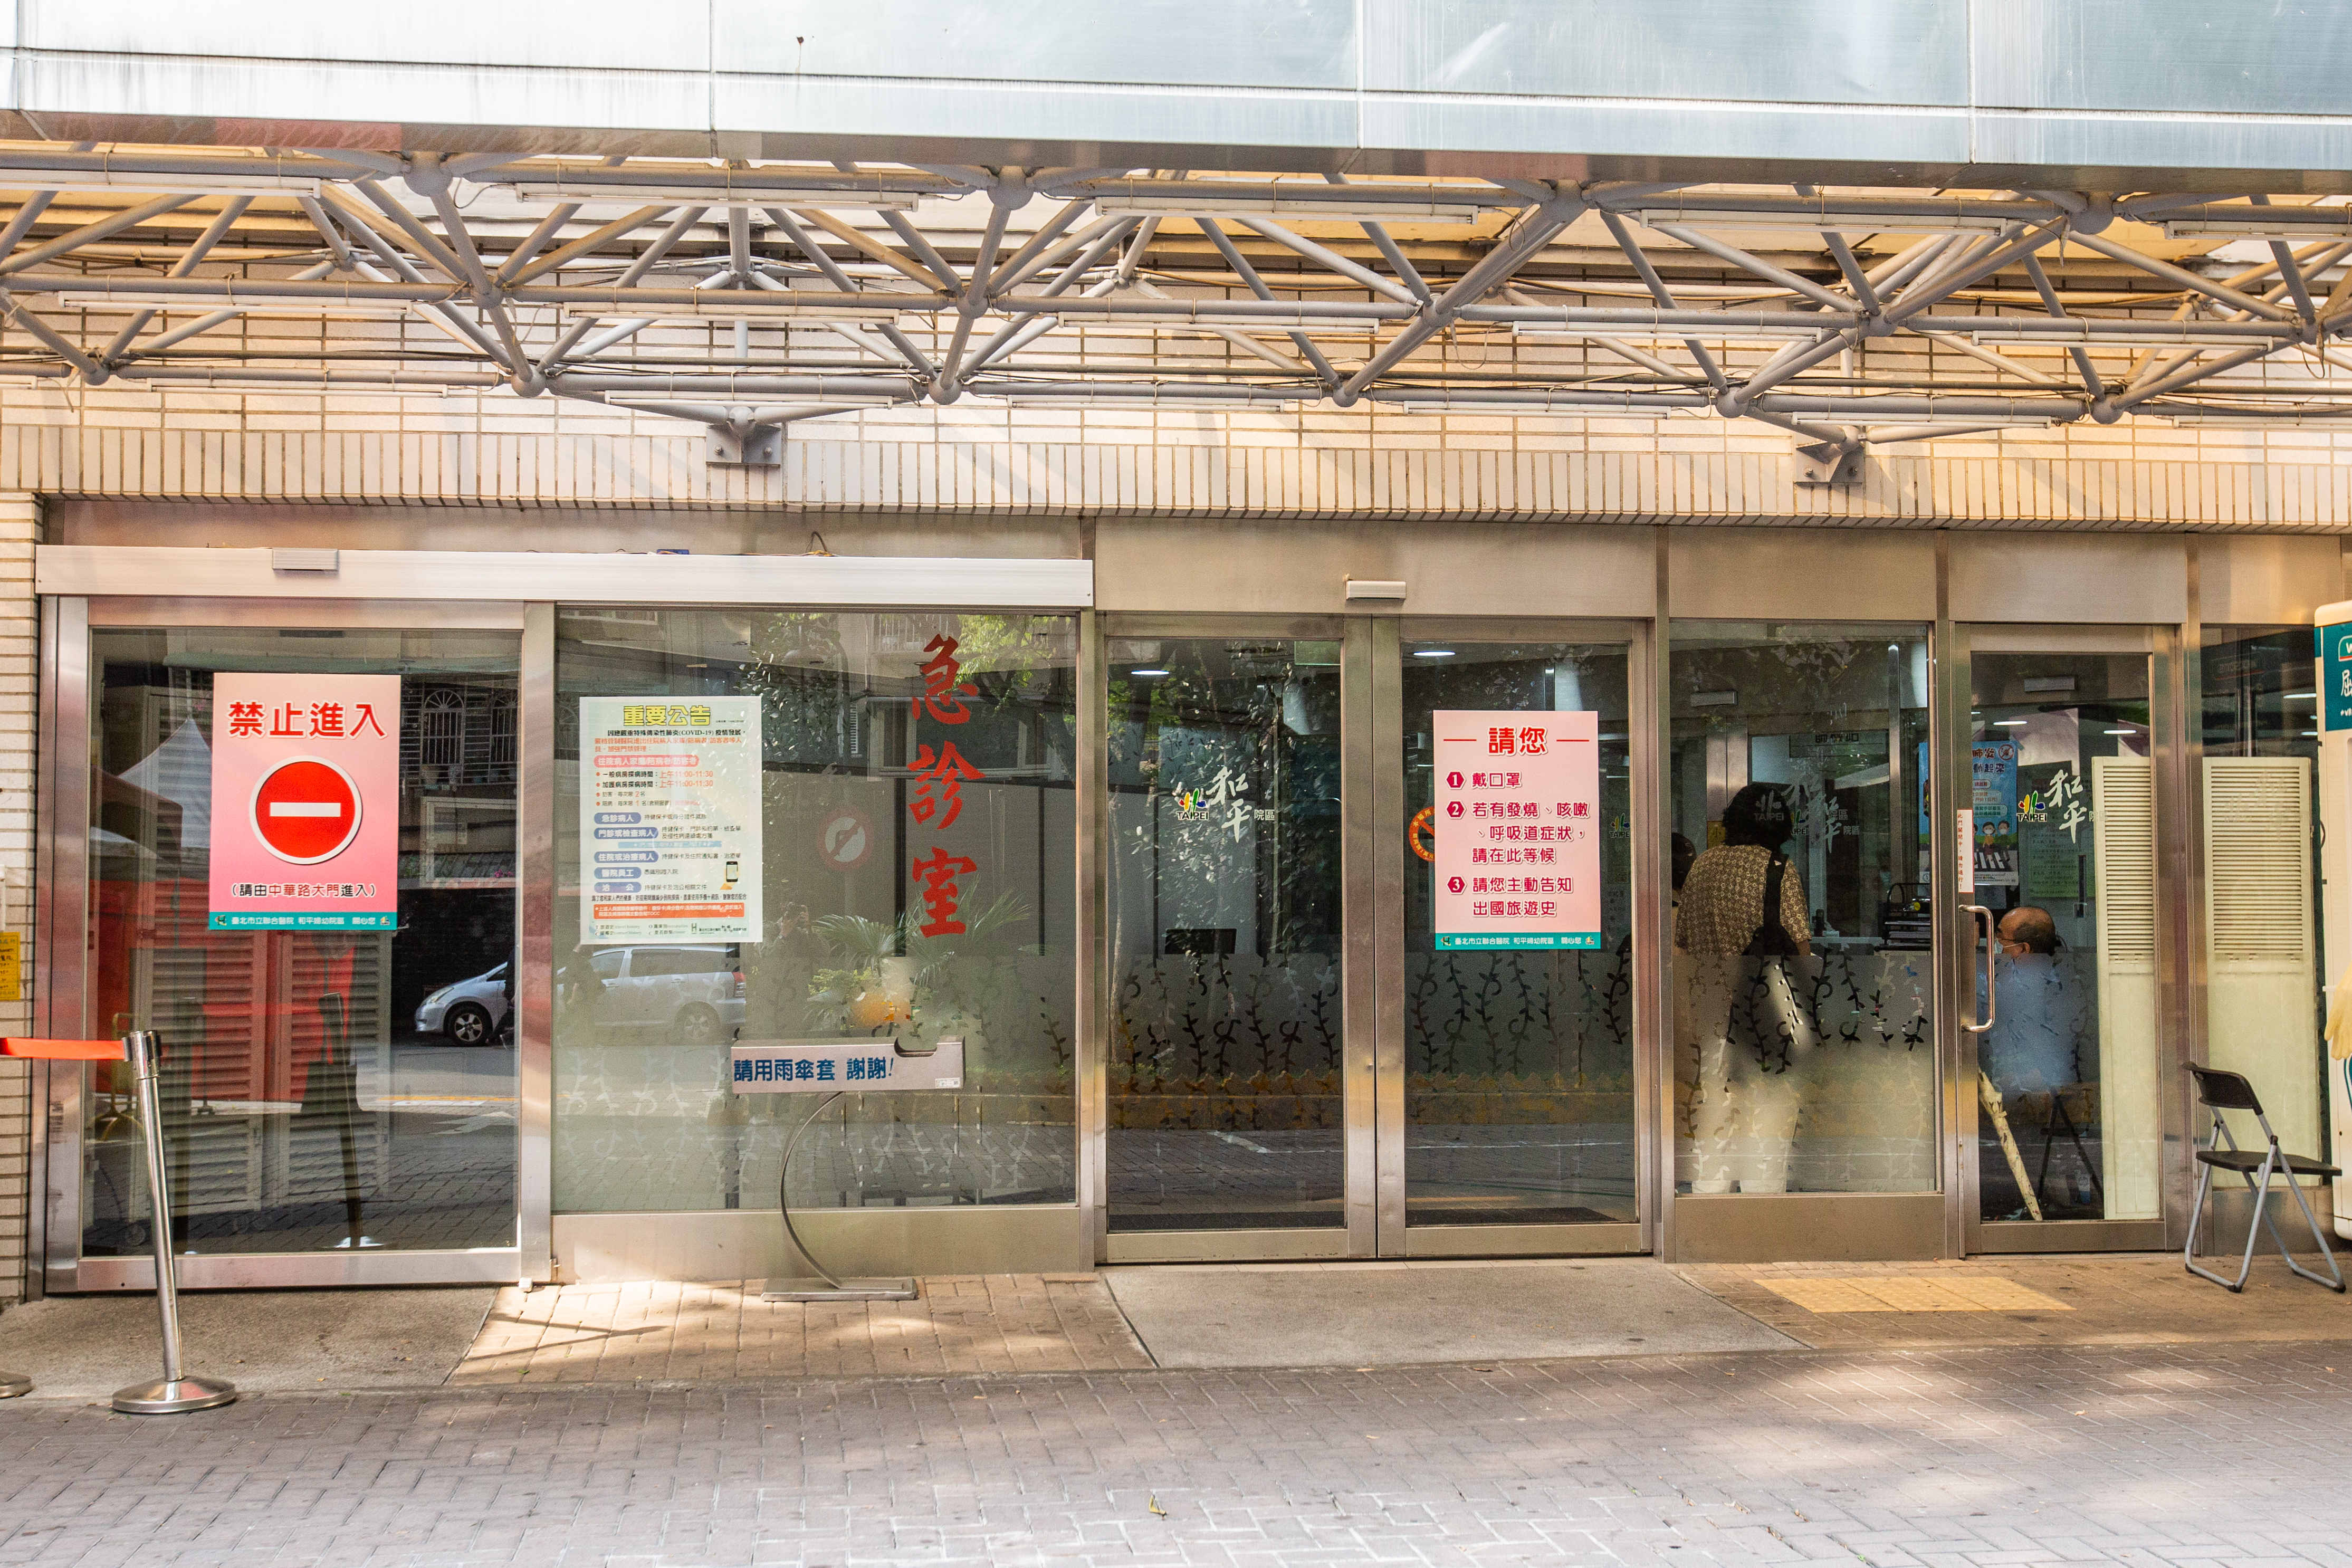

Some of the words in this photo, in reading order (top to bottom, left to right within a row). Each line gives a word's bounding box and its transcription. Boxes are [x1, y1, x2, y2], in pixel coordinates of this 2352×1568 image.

[227, 702, 387, 739] 禁止進入
[624, 705, 710, 726] 重要公告
[1488, 726, 1546, 754] 請您
[907, 634, 985, 938] 急診室
[1472, 772, 1521, 787] 戴口罩
[1177, 811, 1209, 820] TAIPEI
[1254, 809, 1275, 820] 院區
[1473, 802, 1589, 817] 若有發燒、咳嗽
[2017, 813, 2047, 821] TAIPEI
[598, 829, 654, 838] 門診或檢查病人
[1478, 825, 1584, 840] 、呼吸道症狀，
[1843, 826, 1860, 835] 院區
[598, 853, 654, 861] 住院或治療病人
[1473, 847, 1555, 863] 請在此等候
[602, 869, 634, 877] 醫院員工
[232, 884, 376, 897] (請由中華路大門進入)
[1473, 877, 1572, 893] 請您主動告知
[1473, 901, 1555, 916] 出國旅遊史
[734, 1059, 835, 1082] 請用雨傘套
[846, 1057, 894, 1080] 謝謝!
